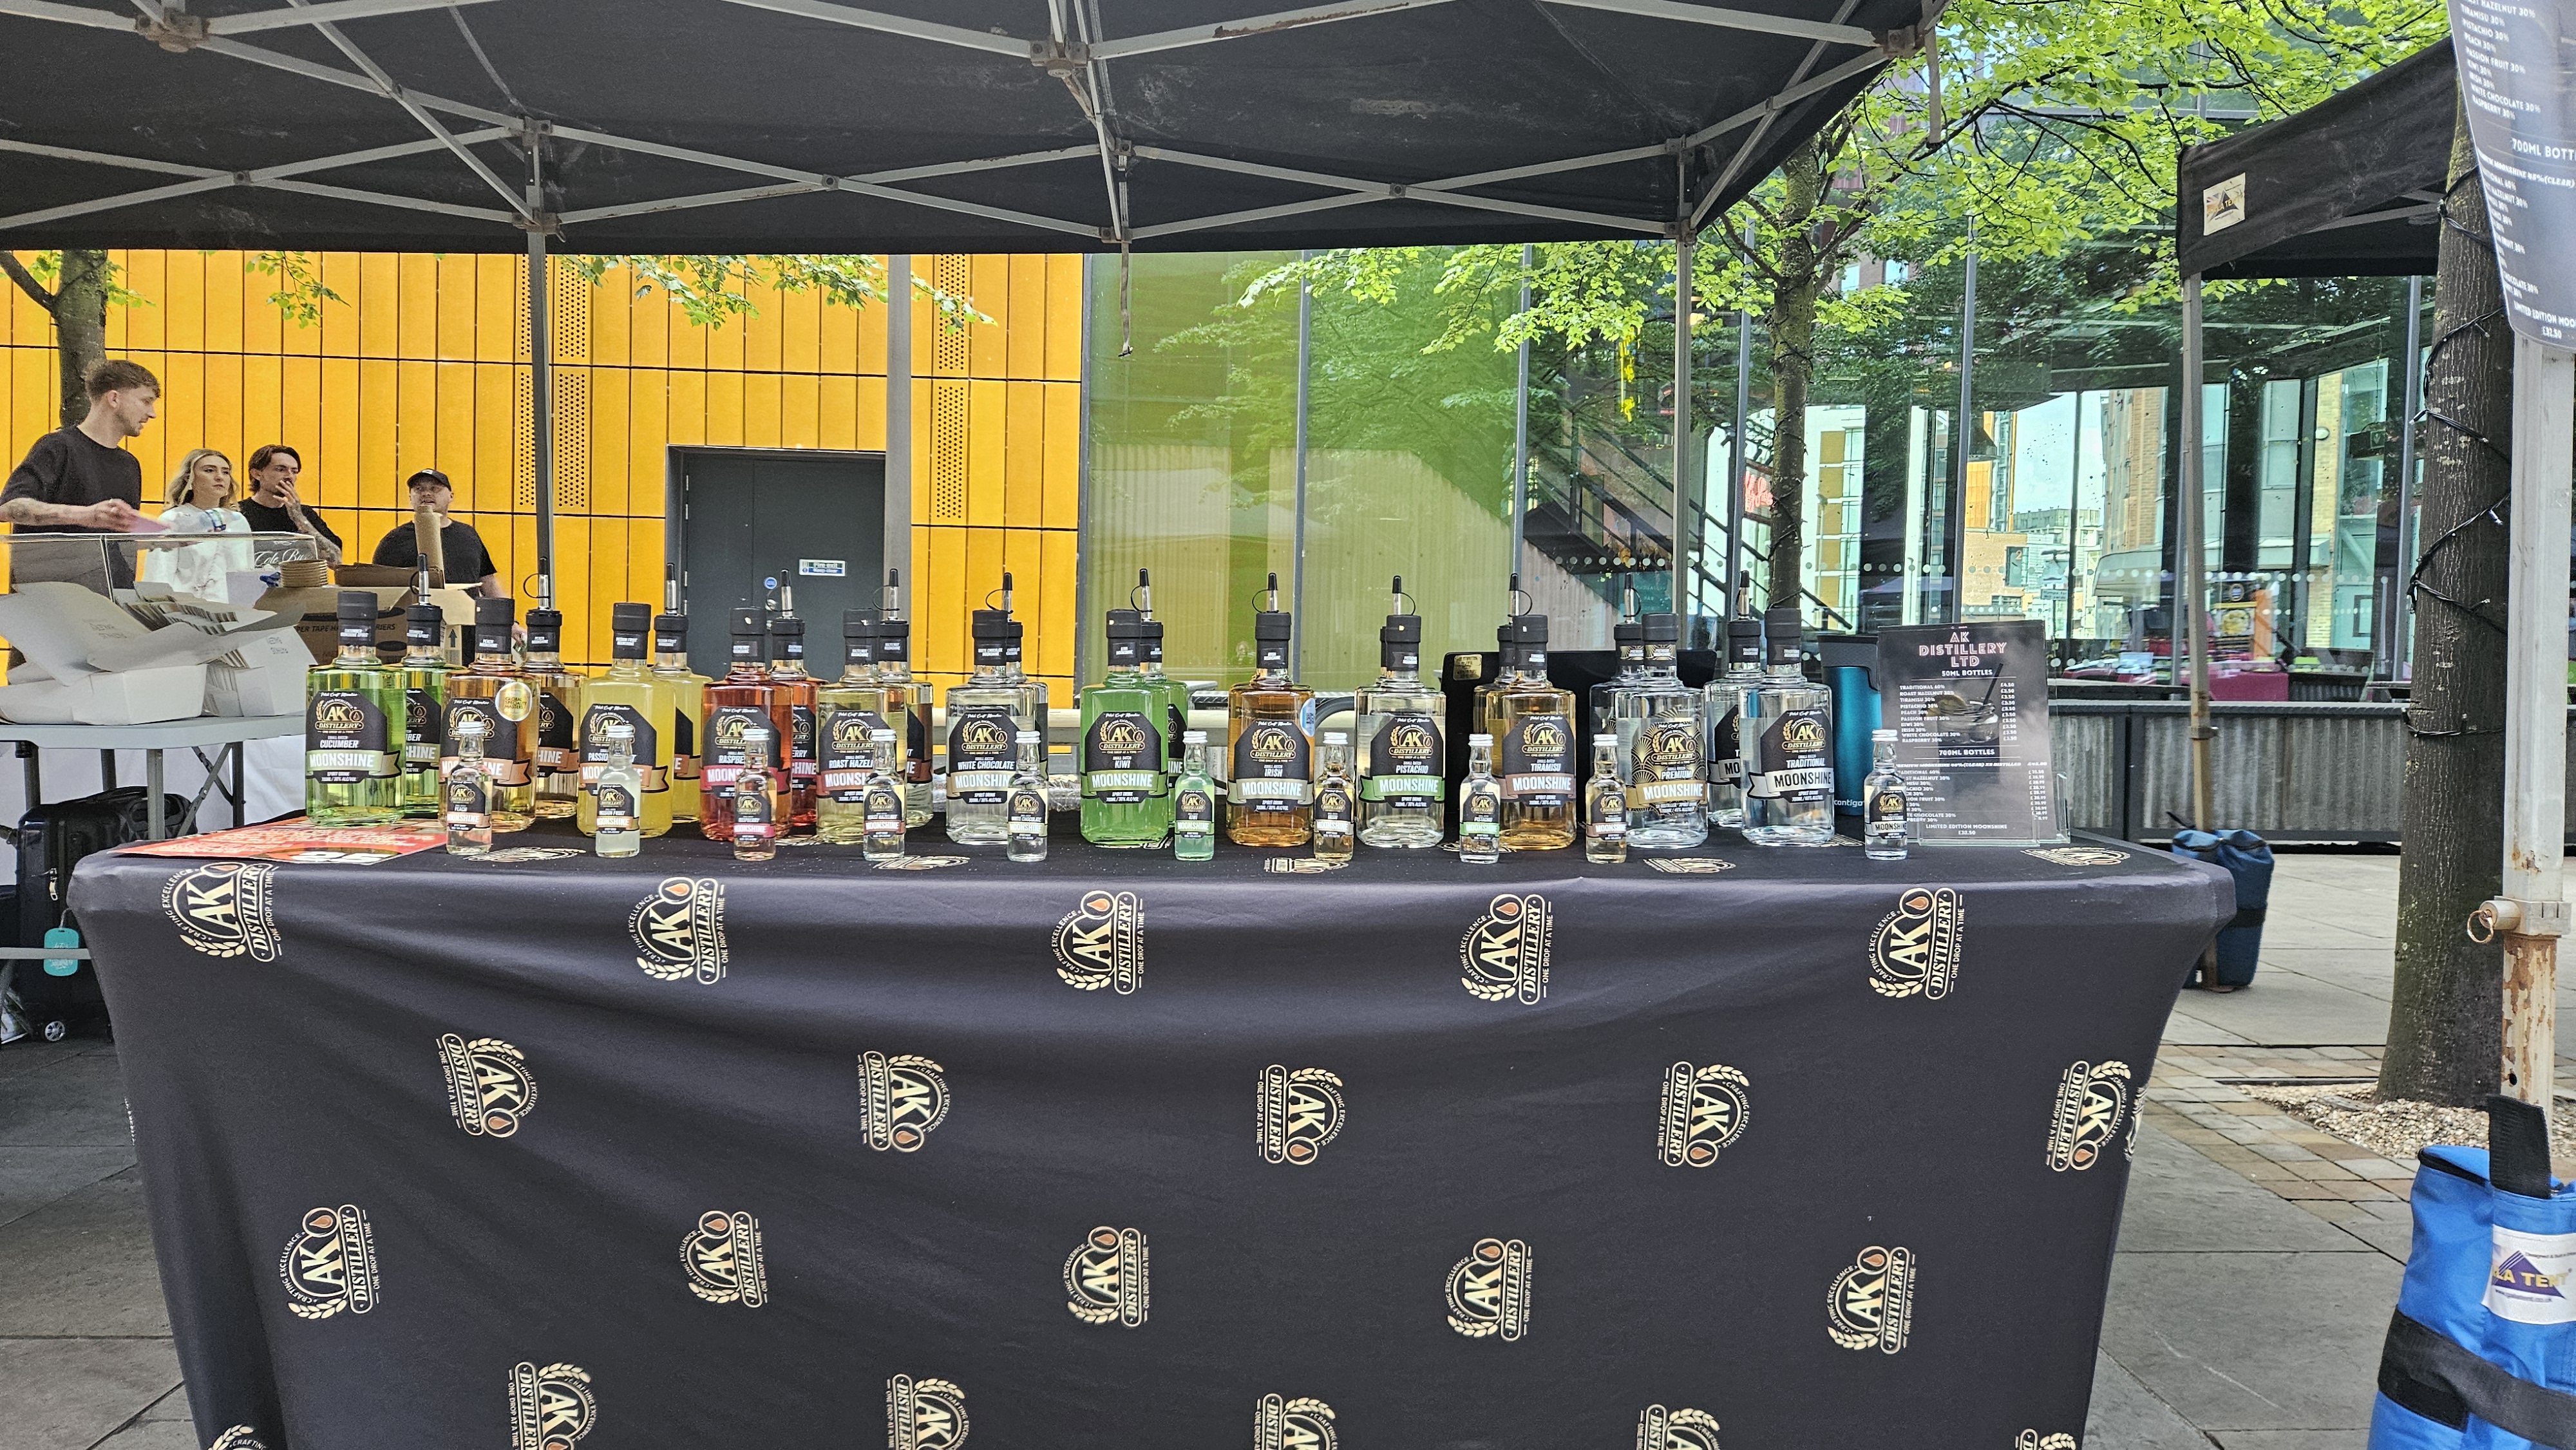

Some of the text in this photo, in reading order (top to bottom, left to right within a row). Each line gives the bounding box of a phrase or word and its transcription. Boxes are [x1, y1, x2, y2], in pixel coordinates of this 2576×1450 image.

[2460, 3, 2505, 26] TIRAMISU 30%
[2519, 8, 2535, 18] 30%
[2462, 18, 2510, 42] PISTACHIO 30%
[2464, 32, 2482, 48] PEACH
[2465, 46, 2526, 74] PASSION FRUIT 30%
[2487, 91, 2524, 110] CHOCOLATE
[2526, 103, 2541, 113] 30%
[2512, 138, 2576, 162] 700ML BOTT
[2532, 309, 2557, 324] EDITION
[2559, 315, 2576, 328] MOO
[1919, 642, 2007, 656] DISTILLERY
[1949, 632, 1970, 643] AK
[1951, 656, 1980, 668] LTD
[327, 706, 348, 721] AK
[320, 740, 359, 748] CUCUMBER
[841, 726, 864, 741] AK
[972, 726, 992, 742] AK
[1109, 726, 1130, 742] AK
[1265, 735, 1282, 750] AK
[1403, 732, 1423, 747] AK
[1535, 730, 1555, 745] AK
[1796, 725, 1817, 740] AK
[1663, 737, 1683, 753] AK
[309, 754, 375, 767] MOONSHINE
[829, 760, 848, 769] ROAST
[958, 761, 1015, 770] WHITE CHOCOLATE
[1115, 760, 1130, 769] KIWI
[1396, 765, 1429, 774] PISTACHIO
[1531, 763, 1561, 772] TIRAMISU
[1786, 758, 1826, 768] TRADITIONAL
[955, 773, 1011, 789] MOONSHIN
[1092, 773, 1153, 788] MOONSHINE
[1264, 769, 1283, 777] IRISH
[1513, 777, 1571, 791] MOONSHINE
[1662, 771, 1692, 780] PREMIUM
[1774, 772, 1832, 787] MOONSHINE
[1242, 781, 1302, 796] MOONSHINE
[1379, 778, 1439, 793] MOONSHINE
[1643, 783, 1703, 800] MOONSHINE
[1834, 799, 1864, 807] contigo
[1875, 822, 1907, 831] MOONSHINE
[186, 876, 243, 938] AK
[242, 865, 269, 951] DISTILLERY
[629, 894, 661, 962] CRAFTING EXCELLENCE
[650, 903, 695, 959] AK
[697, 886, 715, 974] DISTILLERY
[1052, 910, 1080, 974] CRAFTING EXCELLENCE
[1073, 918, 1112, 970] AK
[1118, 900, 1132, 984] DISTILLERY
[1460, 915, 1486, 983] CRAFTING EXCELLENCE
[1480, 922, 1520, 979] AK
[1523, 904, 1540, 993] DISTILLERY
[1869, 910, 1896, 981] CRAFTING EXCELLENCE
[1889, 916, 1931, 977] AK
[1931, 898, 1952, 988] DISTILLERY
[1952, 943, 1962, 962] DROP
[1951, 963, 1959, 979] ONE
[448, 1043, 480, 1128] DISTILLERY
[470, 1057, 521, 1111] AK
[890, 1070, 931, 1124] AK
[1269, 1073, 1282, 1154] DISTILLERY
[1288, 1085, 1325, 1138] AK
[1669, 1072, 1689, 1158] DISTILLERY
[1689, 1085, 1730, 1141] AK
[2056, 1073, 2085, 1162] DISTILLERY
[2076, 1088, 2114, 1142] AK
[299, 1233, 346, 1294] AK
[342, 1214, 368, 1301] DISTILLERY
[695, 1238, 738, 1287] AK
[735, 1220, 757, 1299] DISTILLERY
[1082, 1251, 1119, 1304] AK
[1505, 1247, 1521, 1331] DISTILLERY
[1464, 1263, 1502, 1317] AK
[1846, 1273, 1886, 1329] AK
[1885, 1256, 1905, 1344] DISTILLERY
[539, 1385, 579, 1438] AK
[915, 1396, 952, 1446] AK
